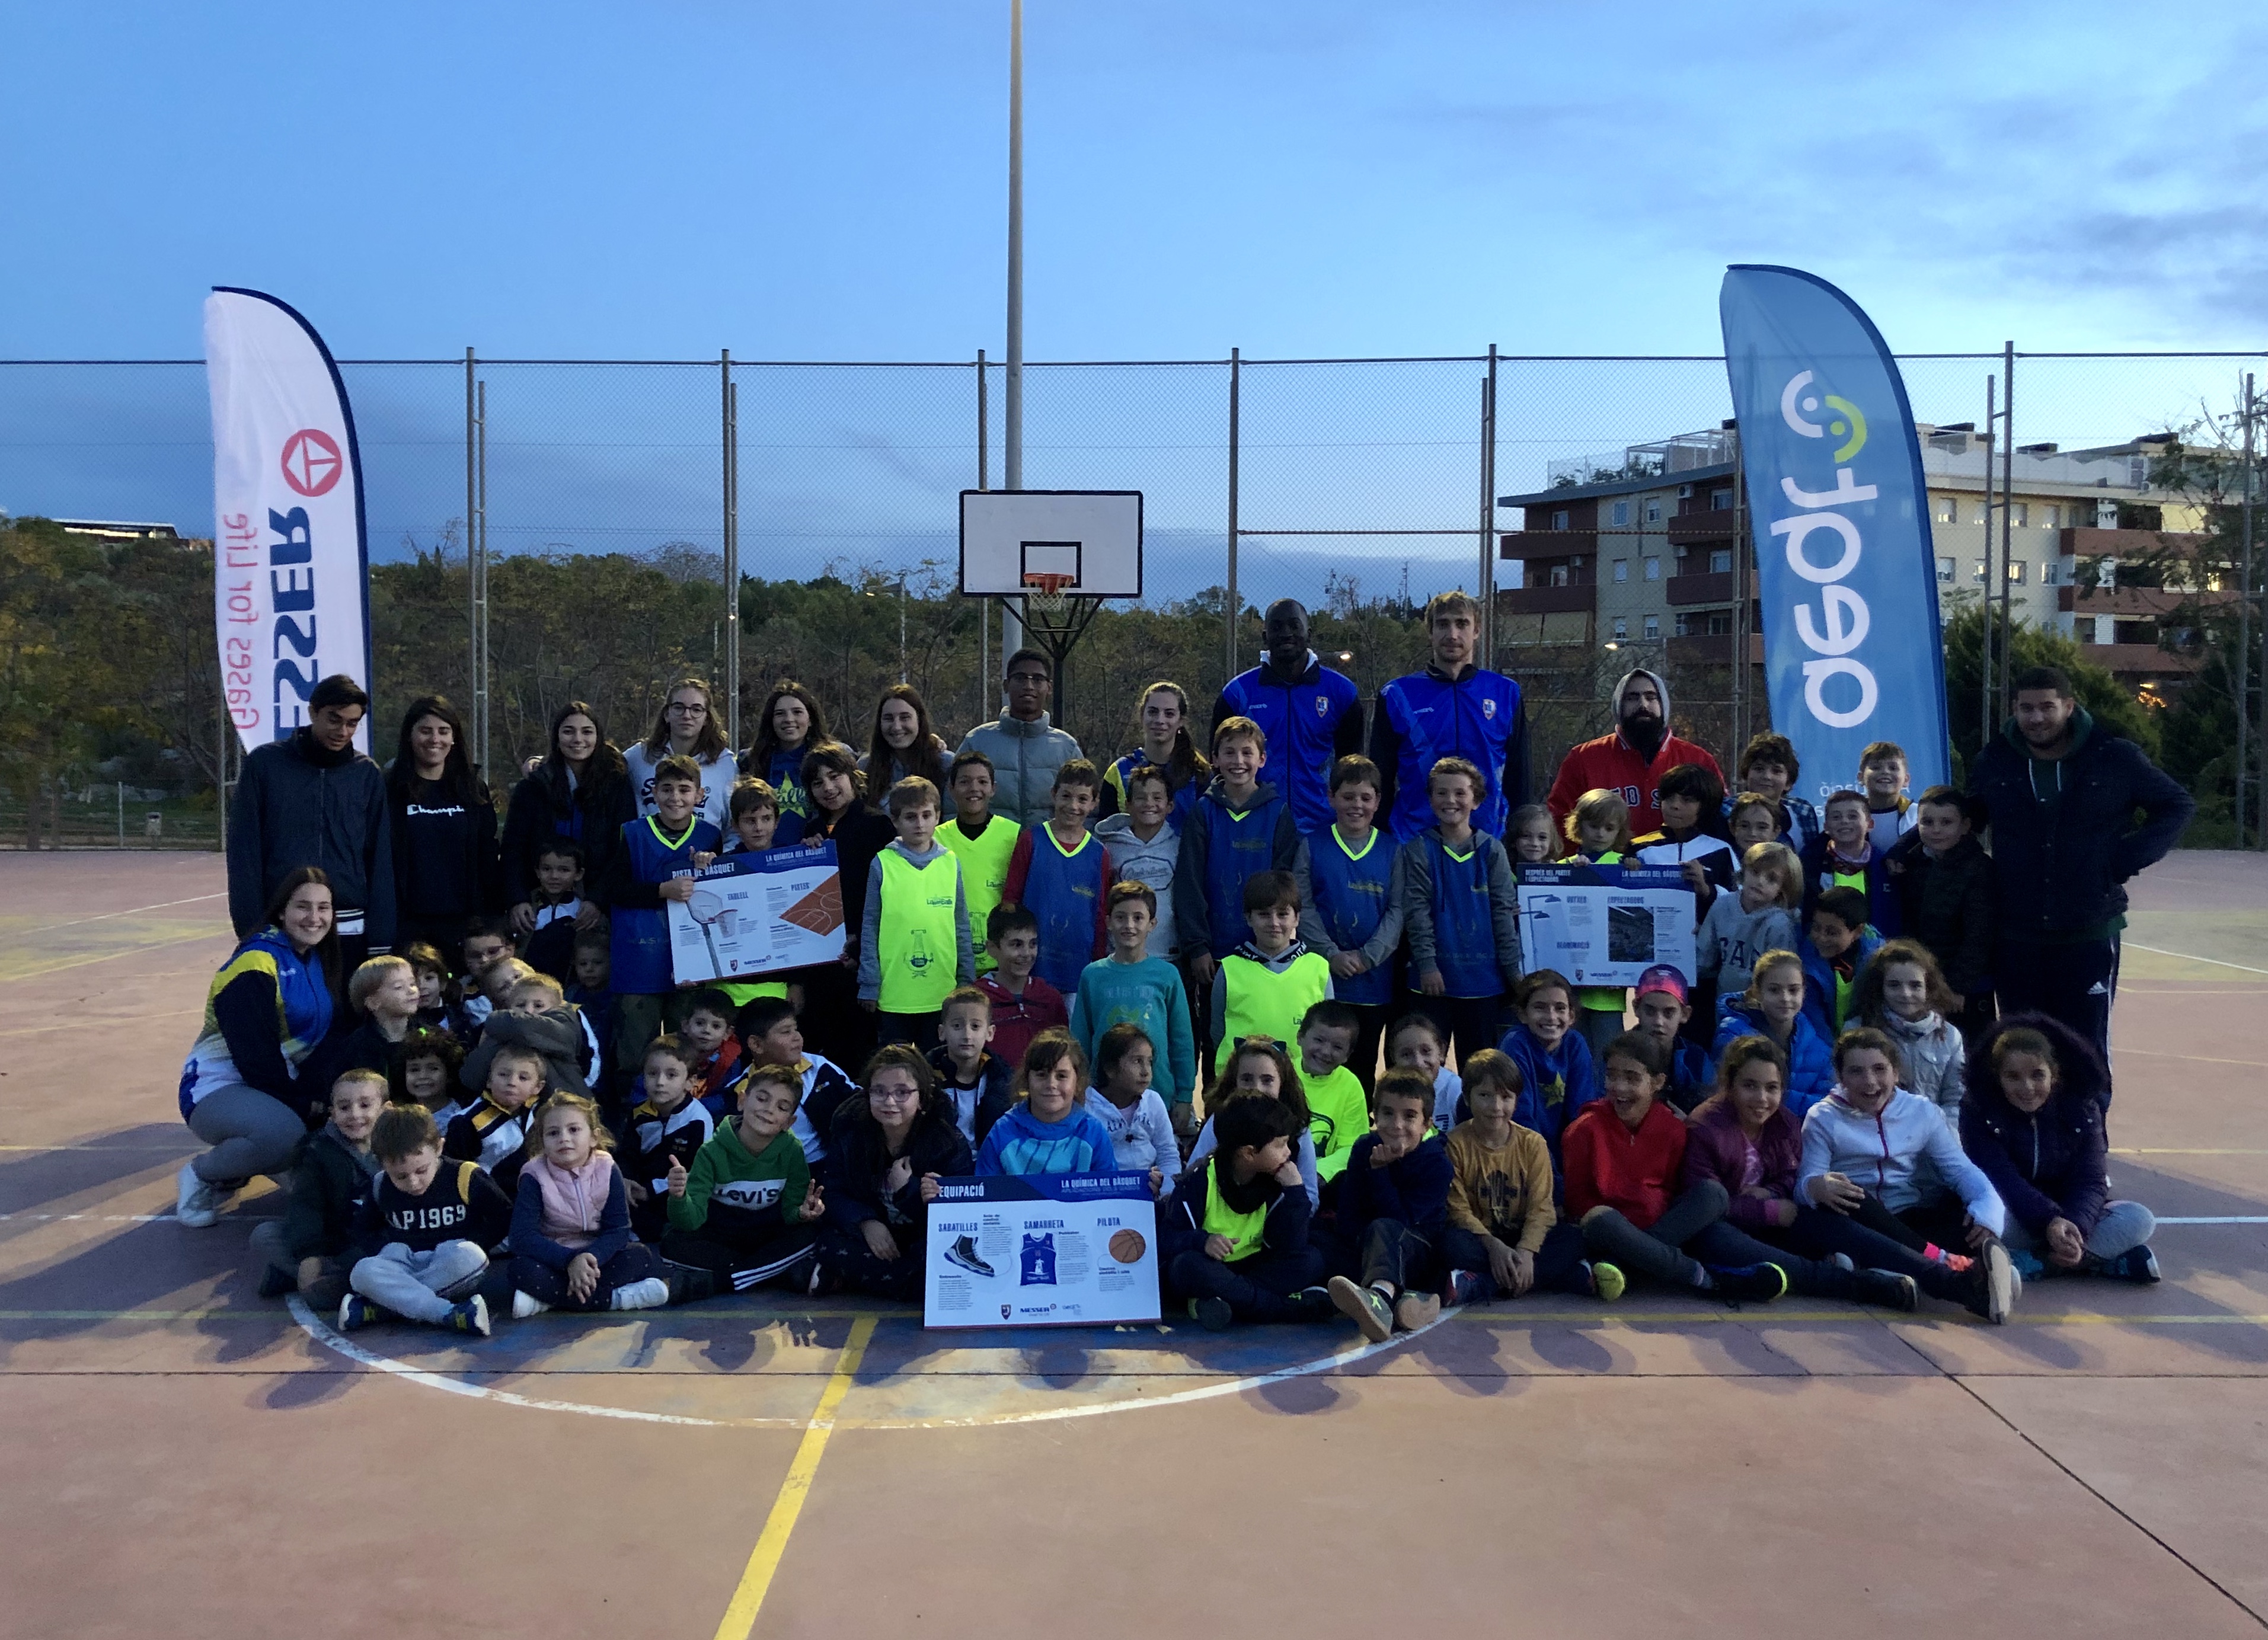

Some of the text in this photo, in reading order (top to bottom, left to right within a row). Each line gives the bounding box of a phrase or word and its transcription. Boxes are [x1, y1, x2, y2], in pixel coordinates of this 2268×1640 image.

[407, 804, 465, 817] Champi
[765, 854, 772, 862] LA
[672, 868, 692, 879] PISTA
[694, 868, 703, 877] DE
[1061, 1175, 1141, 1188] LA QUÍMICA DEL BÀSQUET
[939, 1182, 985, 1198] EQUIPACIÓ
